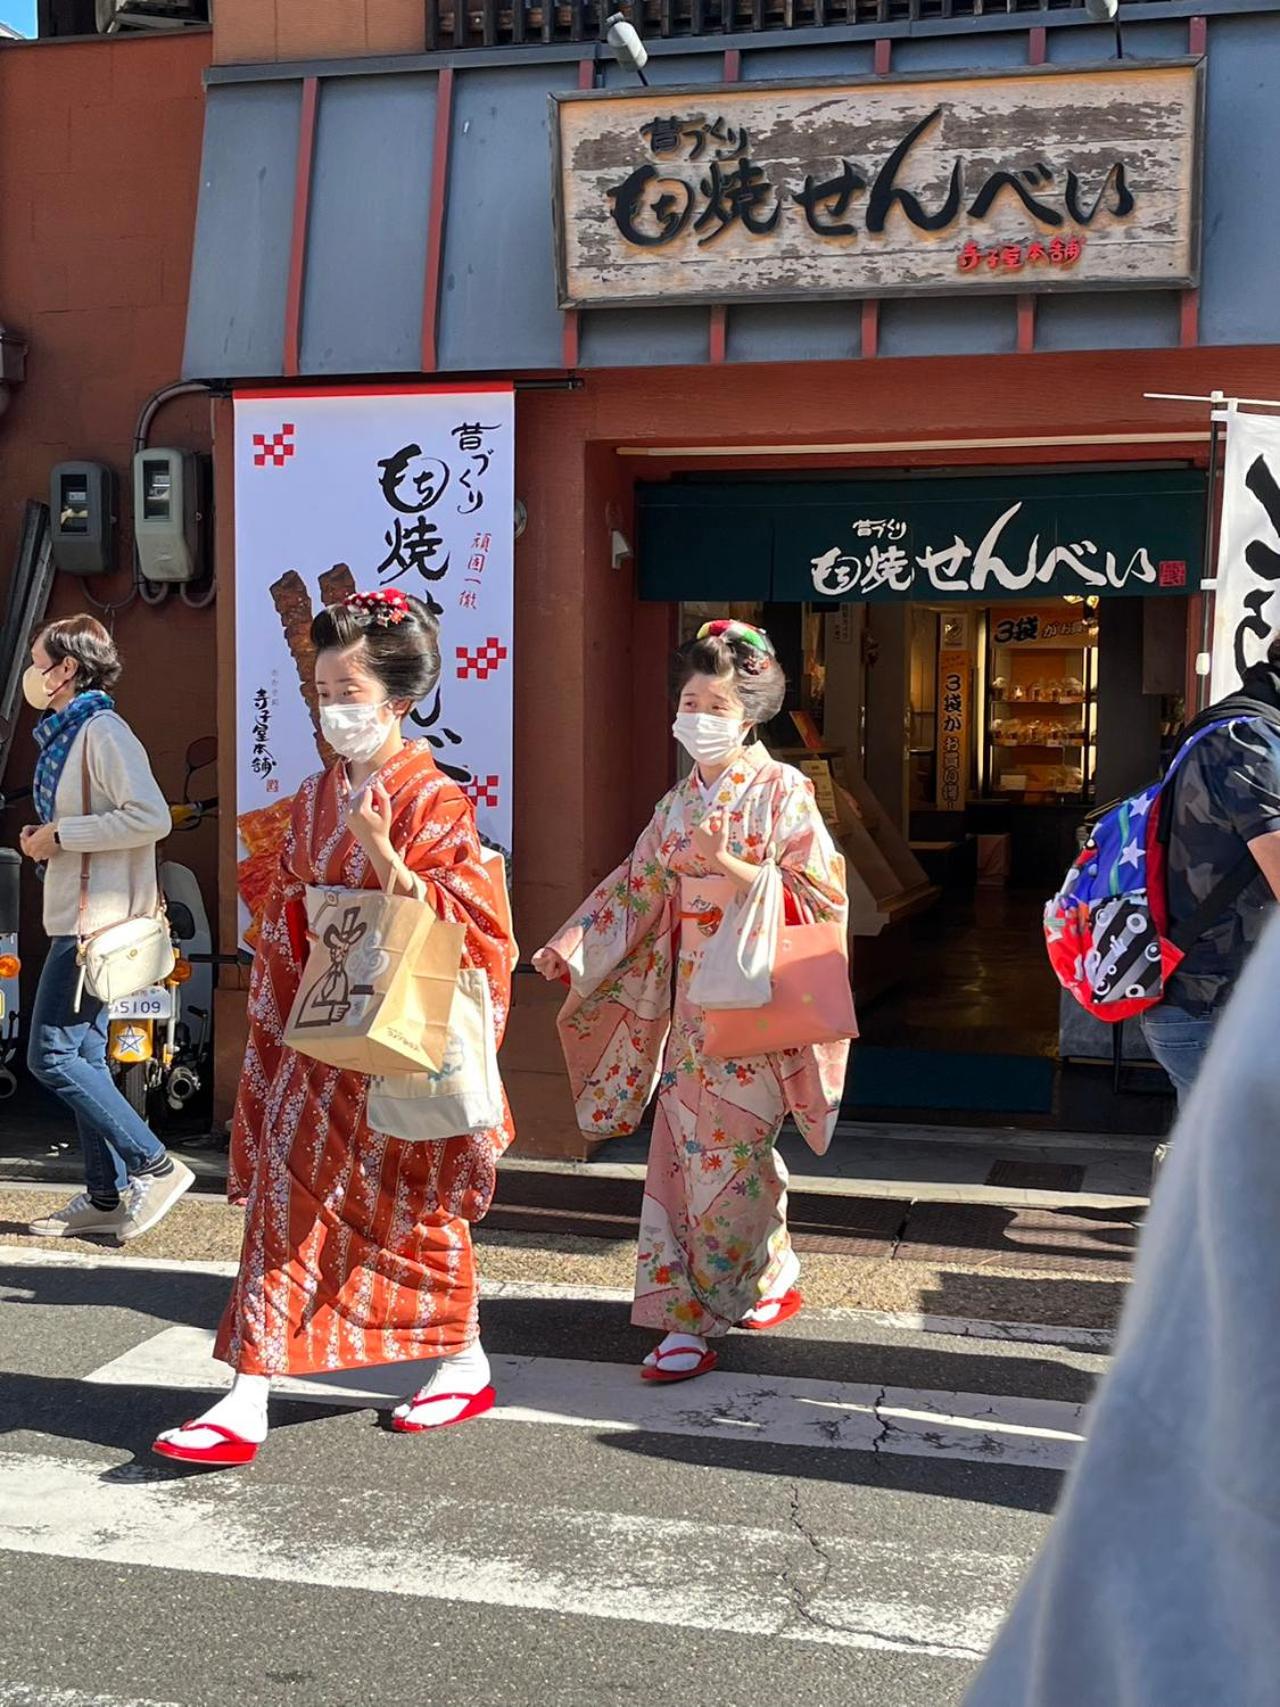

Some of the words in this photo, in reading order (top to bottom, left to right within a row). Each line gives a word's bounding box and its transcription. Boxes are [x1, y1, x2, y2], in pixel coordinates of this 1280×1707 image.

[606, 107, 1135, 246] もち焼せんべい
[639, 115, 750, 162] 昔づくり
[958, 236, 1087, 272] 寺子屋本舗
[451, 422, 502, 514] 昔づくり
[811, 501, 1157, 595] もち焼せんべい
[852, 518, 908, 540] 昔づくり
[251, 687, 277, 780] 寺子屋本舗
